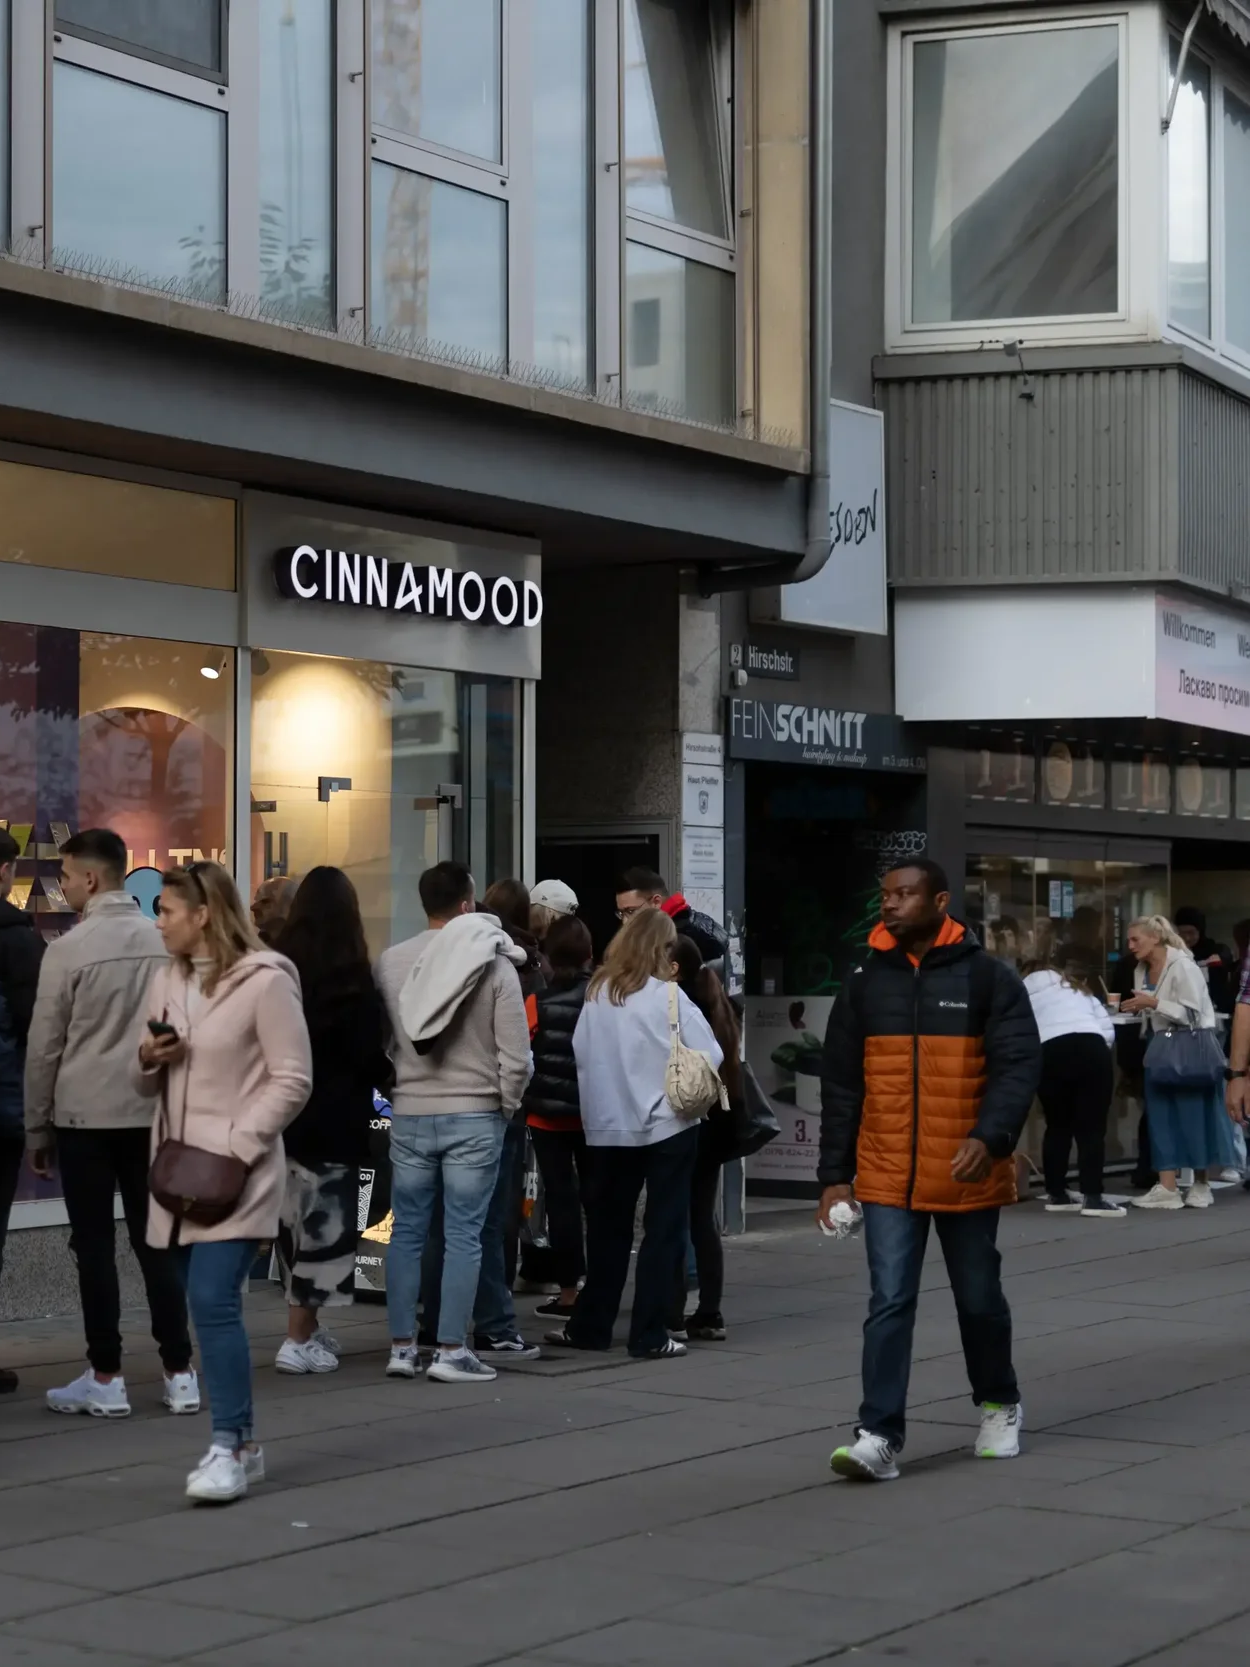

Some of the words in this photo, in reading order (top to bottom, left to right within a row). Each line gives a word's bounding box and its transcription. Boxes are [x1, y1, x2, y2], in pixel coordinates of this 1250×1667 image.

[290, 544, 543, 627] CINNAMOOD
[1162, 610, 1217, 650] Willkommen
[733, 645, 741, 664] 2
[748, 645, 794, 673] Hirschstr.
[1178, 668, 1217, 701] Ласкаво
[732, 698, 868, 749] FEINSCHNITT
